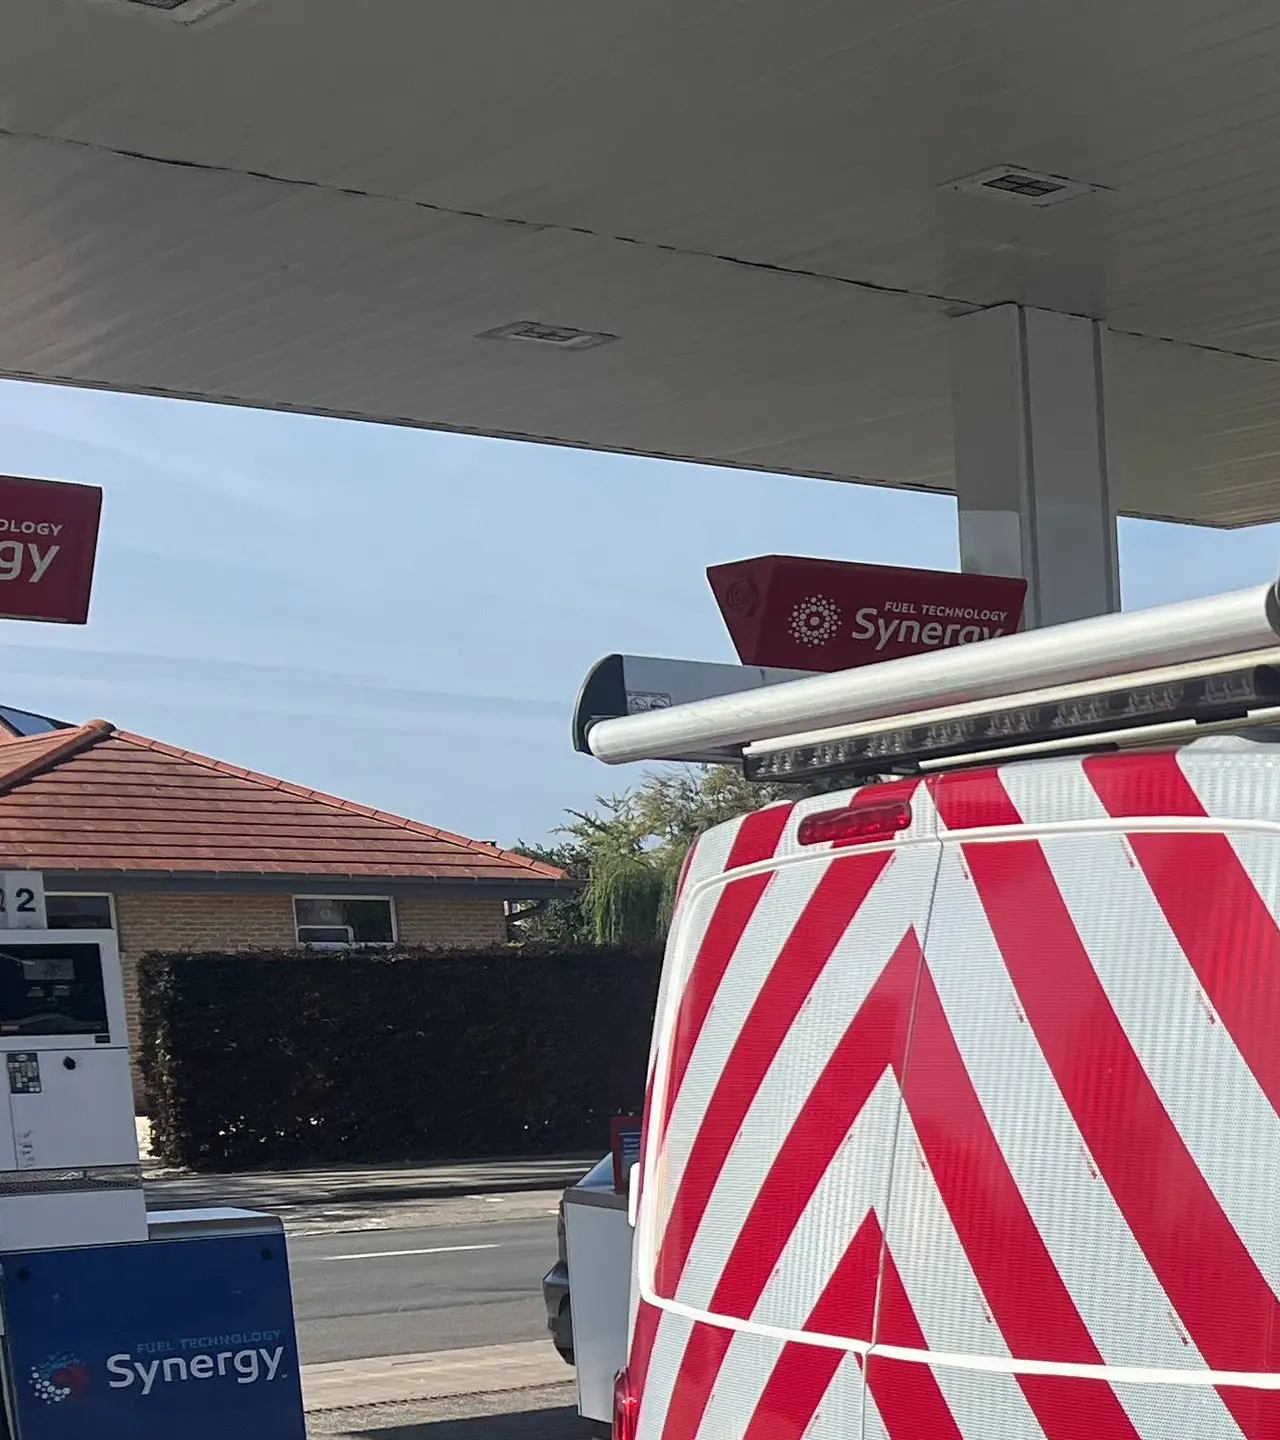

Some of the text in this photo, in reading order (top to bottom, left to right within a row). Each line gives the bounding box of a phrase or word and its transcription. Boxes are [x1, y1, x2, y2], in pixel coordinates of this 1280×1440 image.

[884, 601, 1008, 622] FUEL TECHNOLOGY
[137, 1329, 282, 1354] FUEL TECHNOLOGY
[106, 1346, 284, 1395] Synergy
